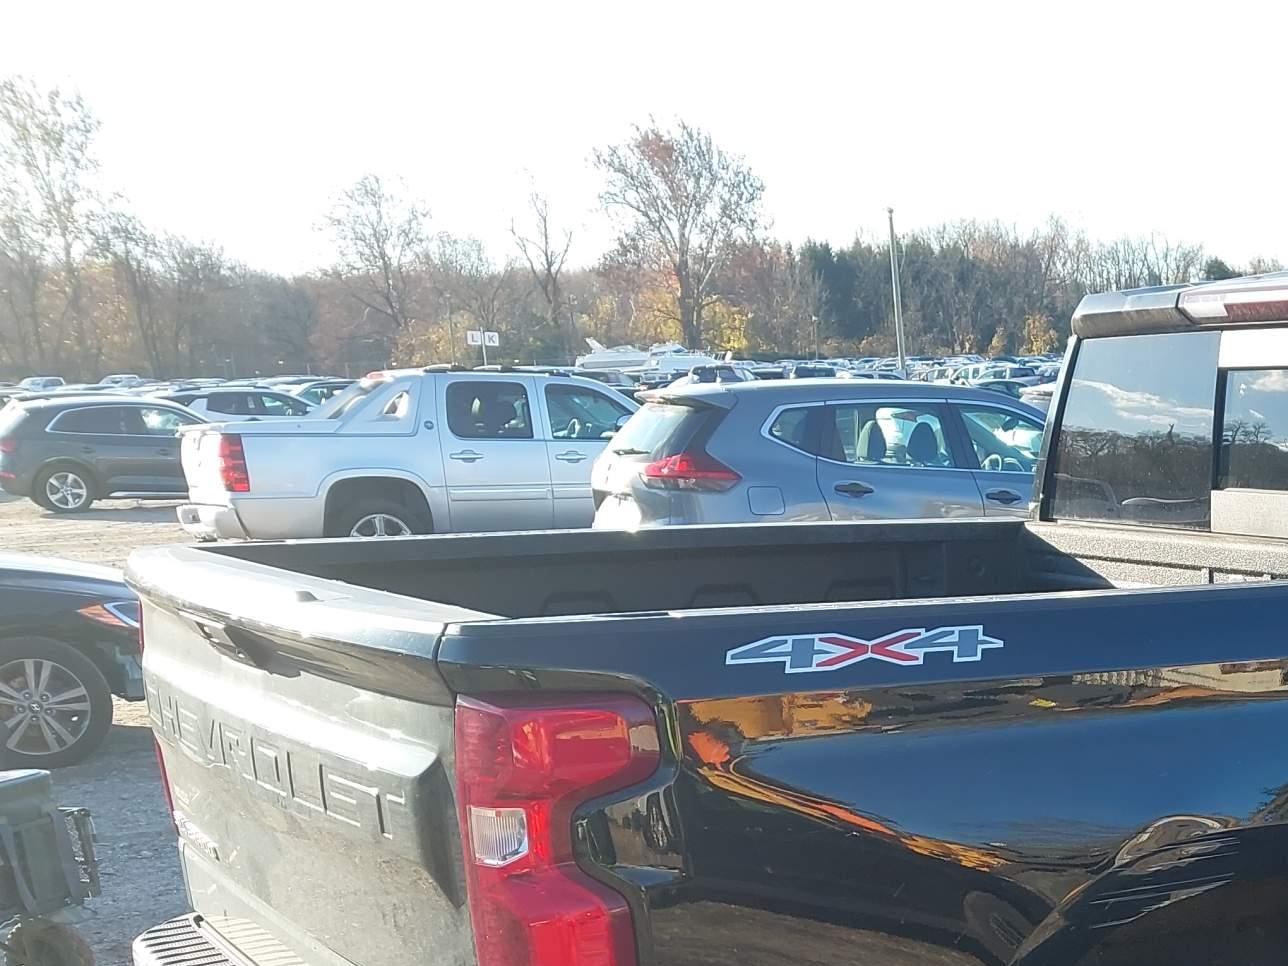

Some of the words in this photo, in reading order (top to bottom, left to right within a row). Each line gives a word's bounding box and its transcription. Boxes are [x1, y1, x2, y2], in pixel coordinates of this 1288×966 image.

[471, 333, 480, 343] L
[487, 334, 496, 344] K
[145, 679, 405, 840] CHEVROLET
